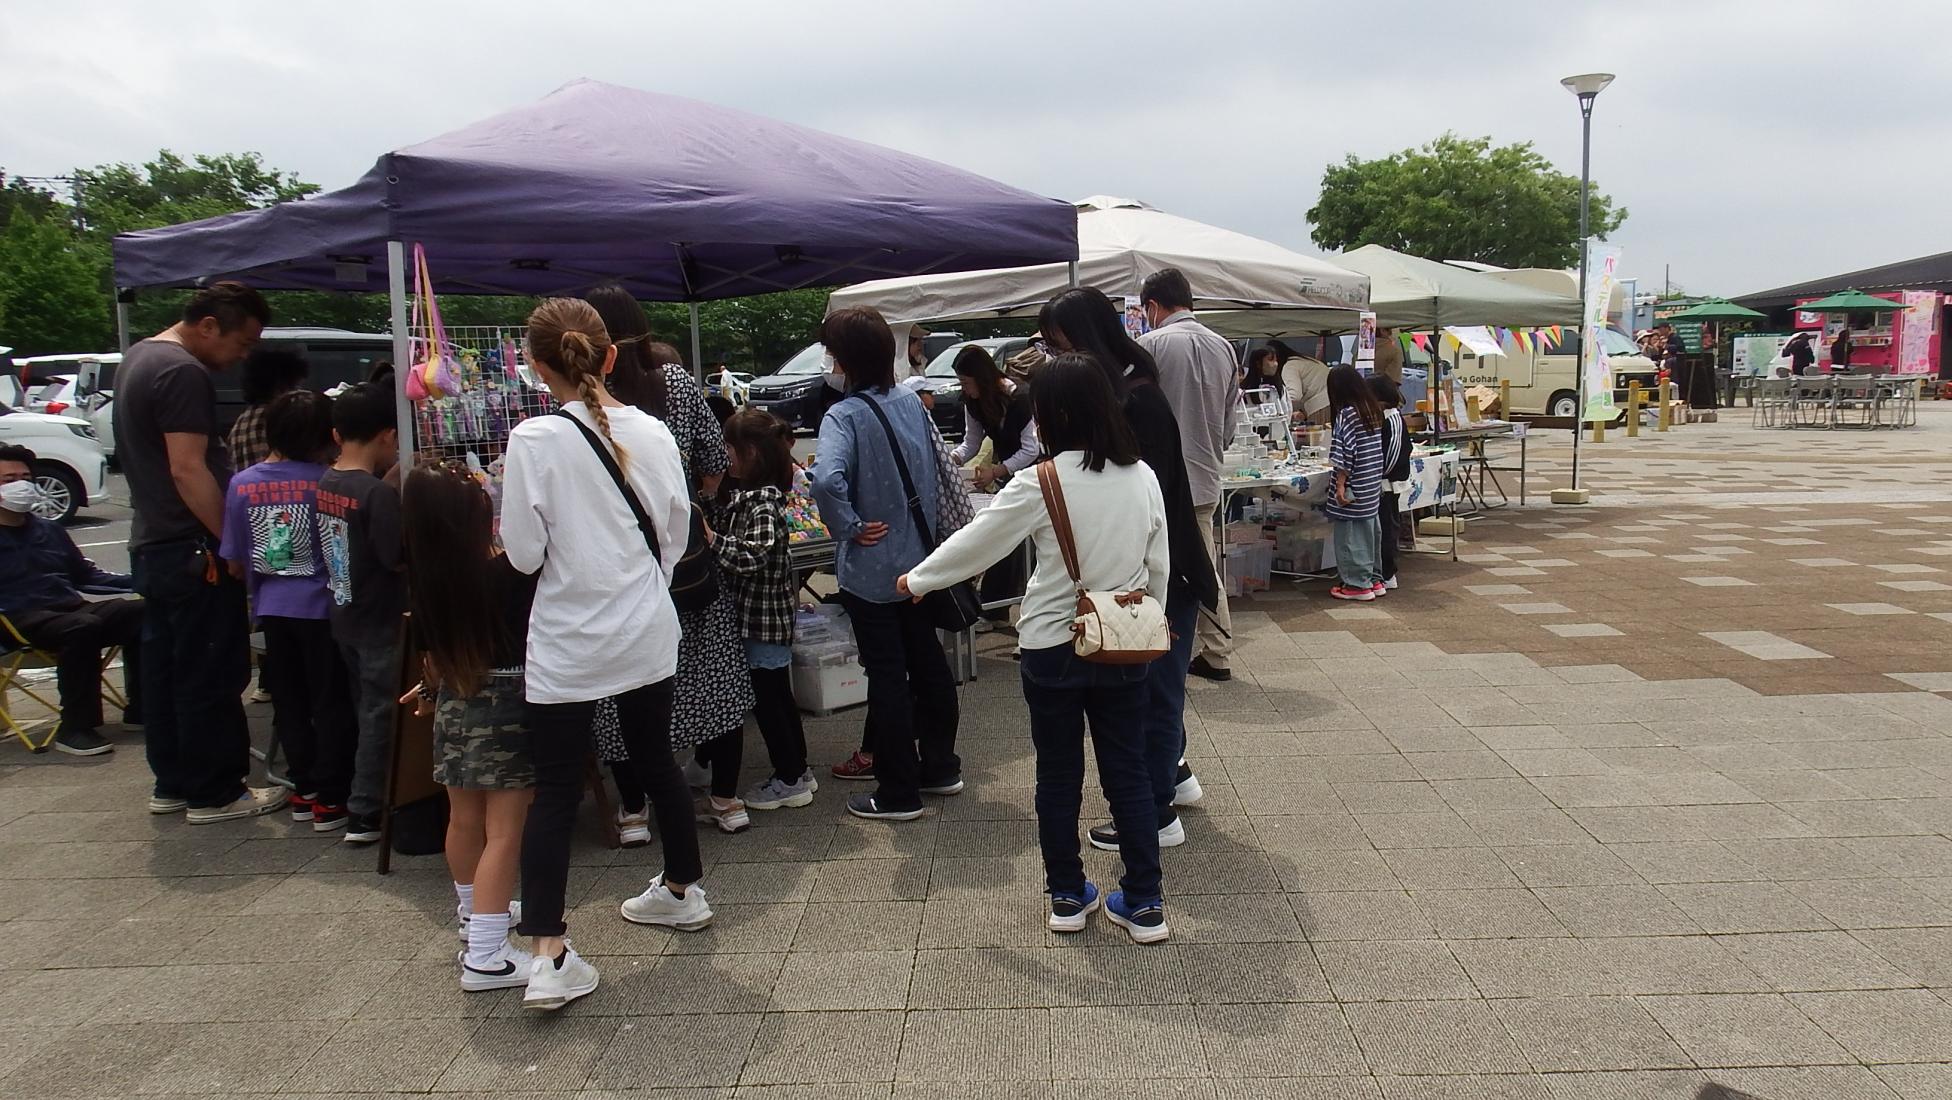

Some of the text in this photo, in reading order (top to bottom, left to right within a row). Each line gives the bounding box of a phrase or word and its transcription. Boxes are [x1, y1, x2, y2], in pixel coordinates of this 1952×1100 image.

[1469, 375, 1498, 383] Gohan
[236, 480, 318, 496] ROADSIDE
[249, 490, 304, 504] DINER
